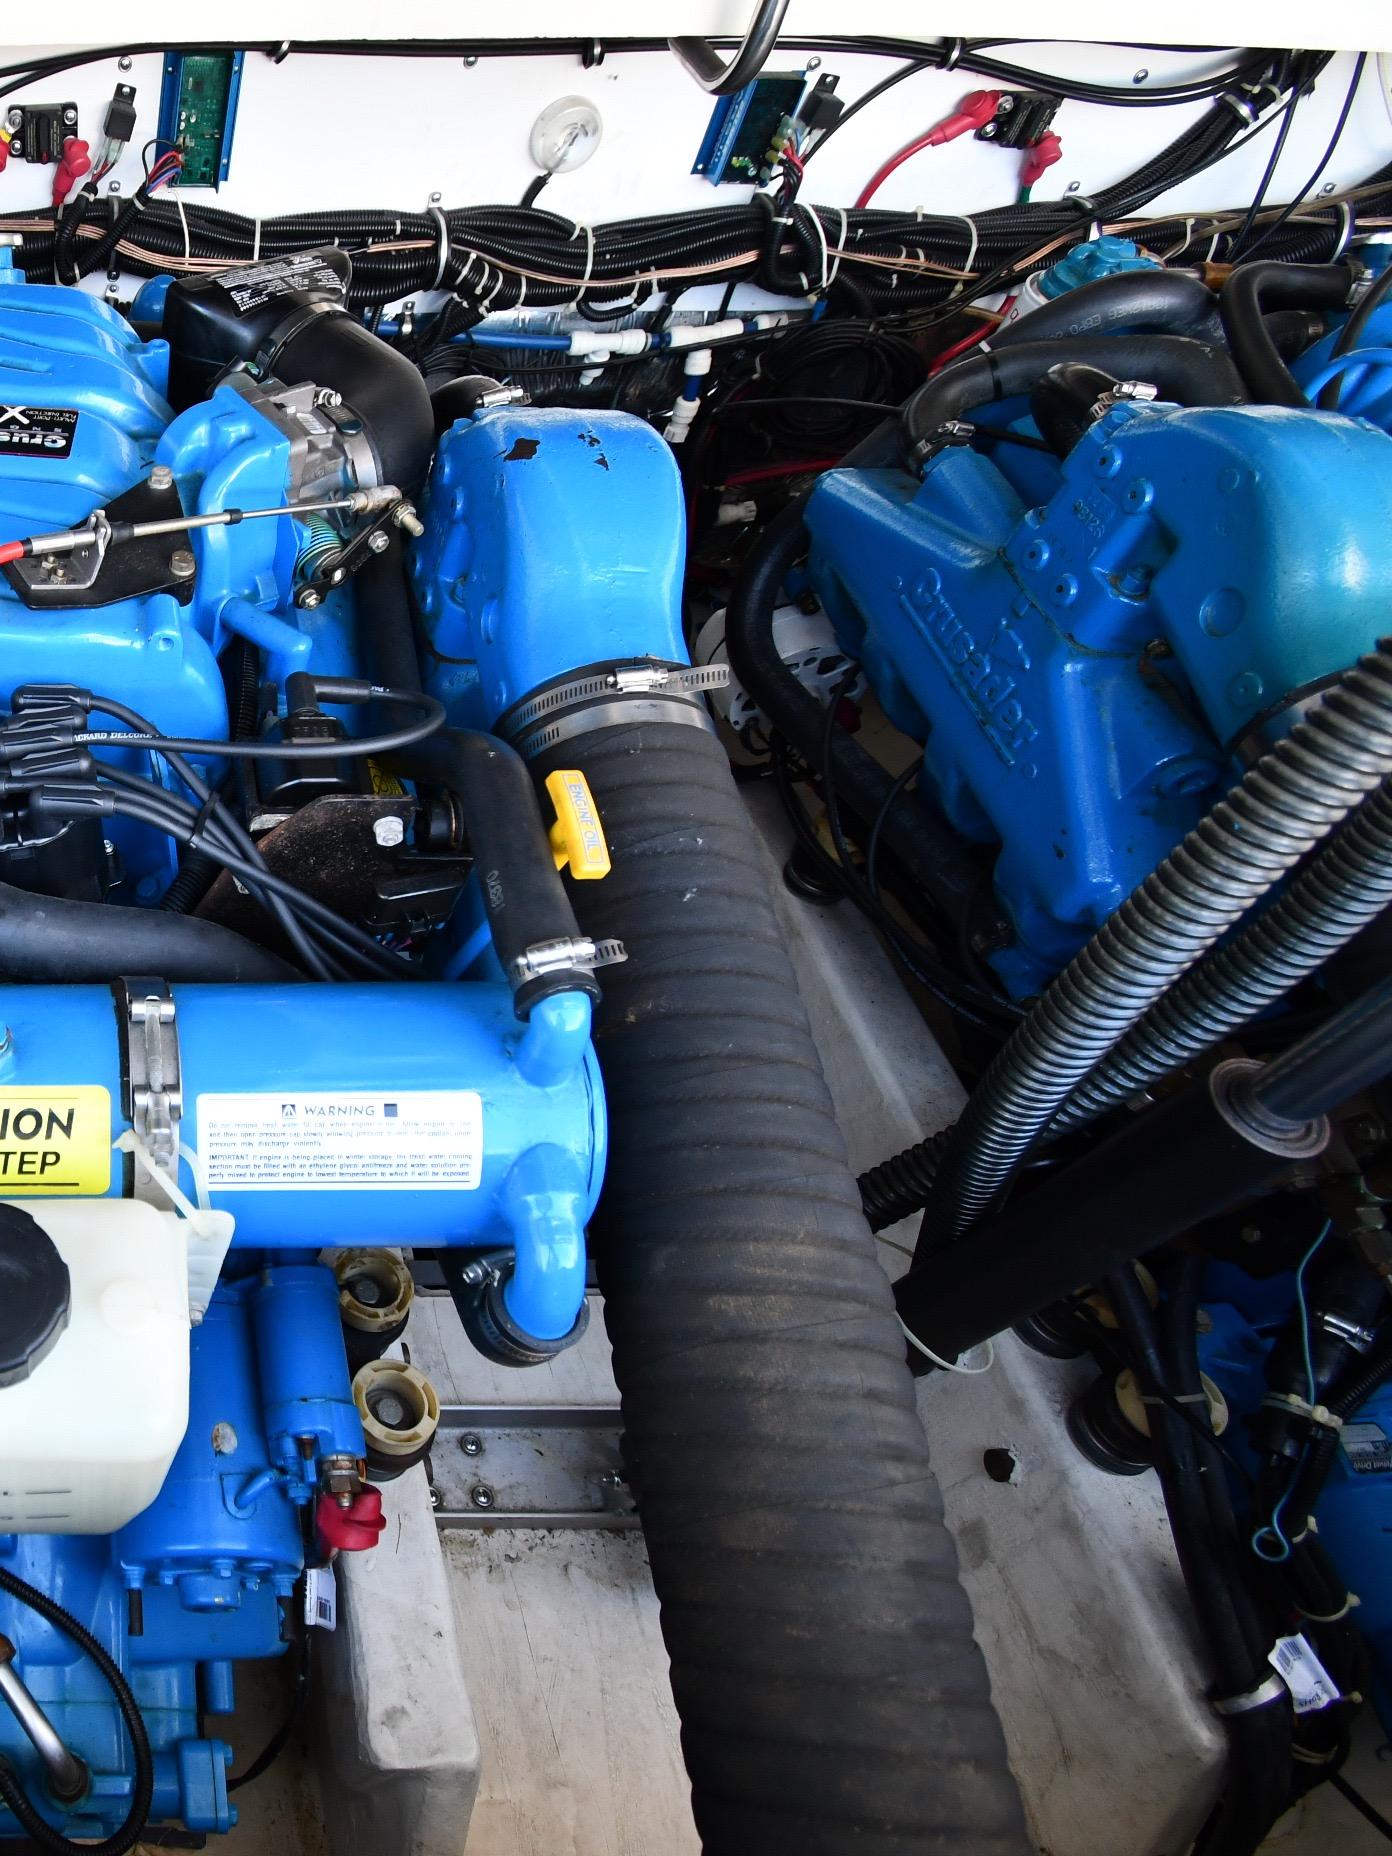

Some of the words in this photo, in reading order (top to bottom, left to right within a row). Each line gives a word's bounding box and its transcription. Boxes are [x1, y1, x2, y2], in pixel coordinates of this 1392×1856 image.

[917, 567, 1039, 750] Crusader
[73, 732, 107, 742] ACKARD
[568, 783, 594, 826] ENGINE
[584, 830, 602, 849] OIL
[305, 1105, 375, 1117] WARNING
